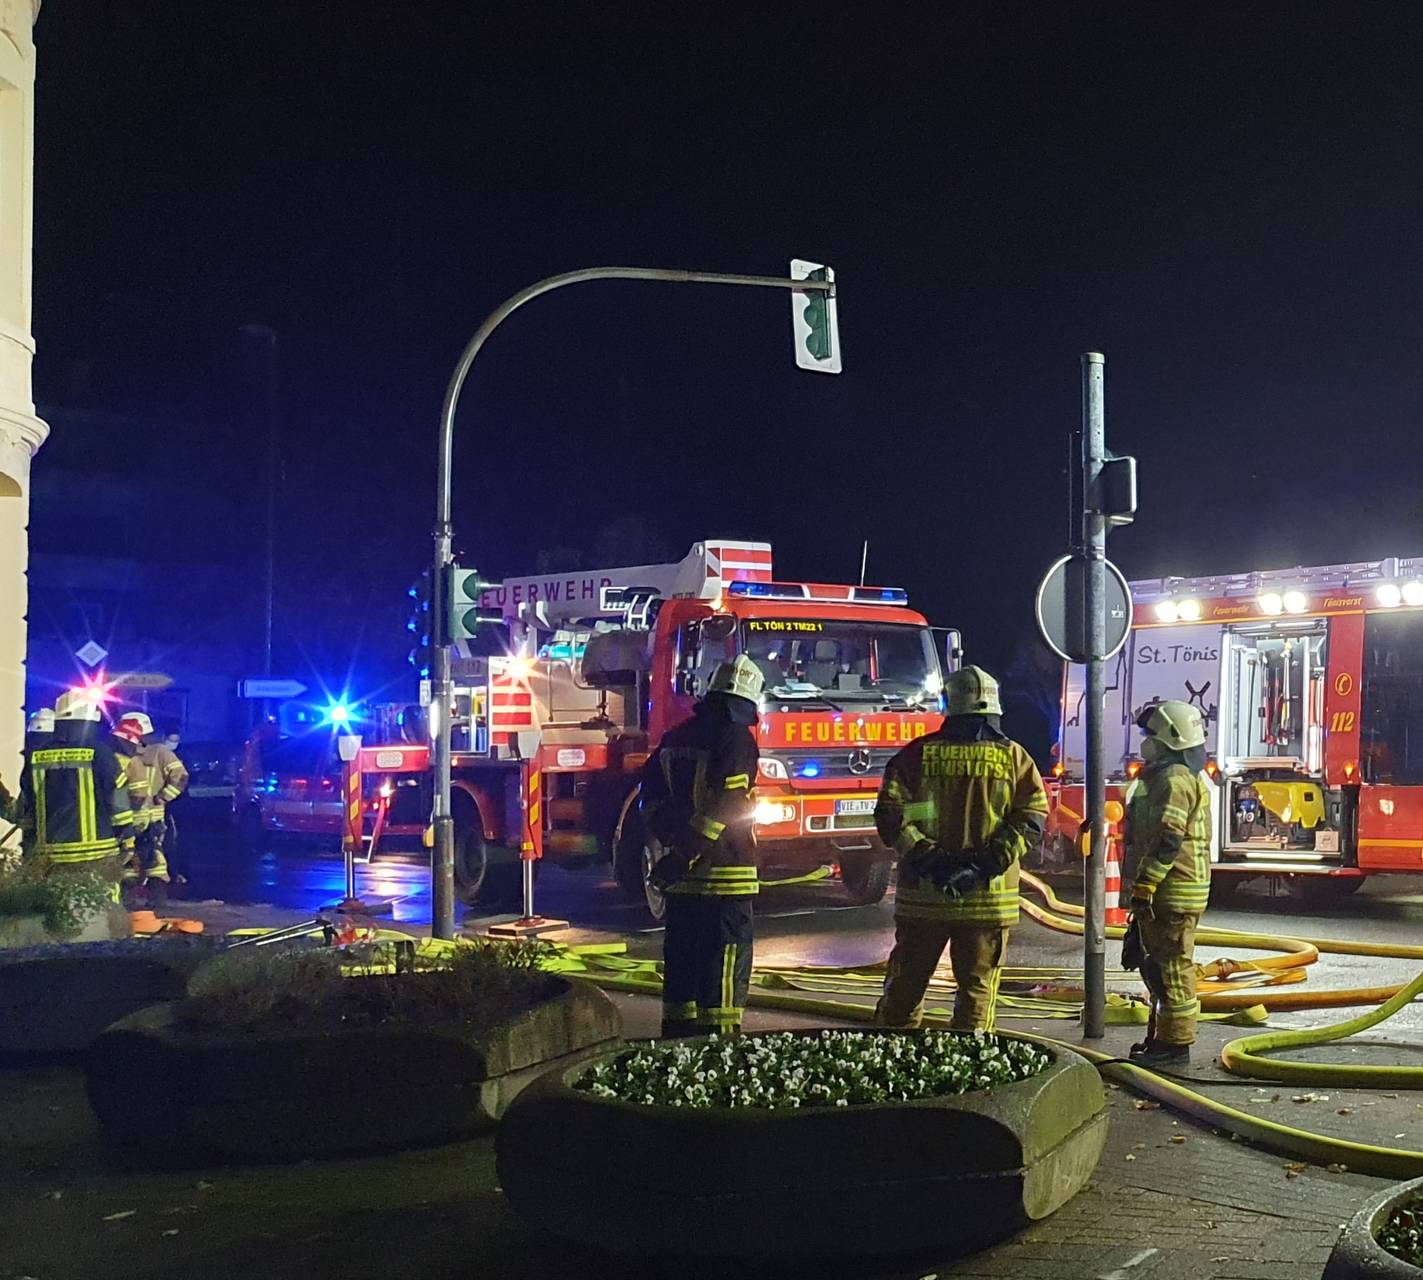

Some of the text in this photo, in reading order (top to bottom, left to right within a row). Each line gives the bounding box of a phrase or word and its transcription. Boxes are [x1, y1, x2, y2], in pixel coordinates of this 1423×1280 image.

[480, 577, 612, 607] EUERWEH
[750, 622, 762, 631] FL
[786, 622, 792, 631] 2
[1168, 645, 1218, 663] Tönis
[1330, 711, 1355, 732] 112
[785, 722, 926, 742] FEUERWEHR
